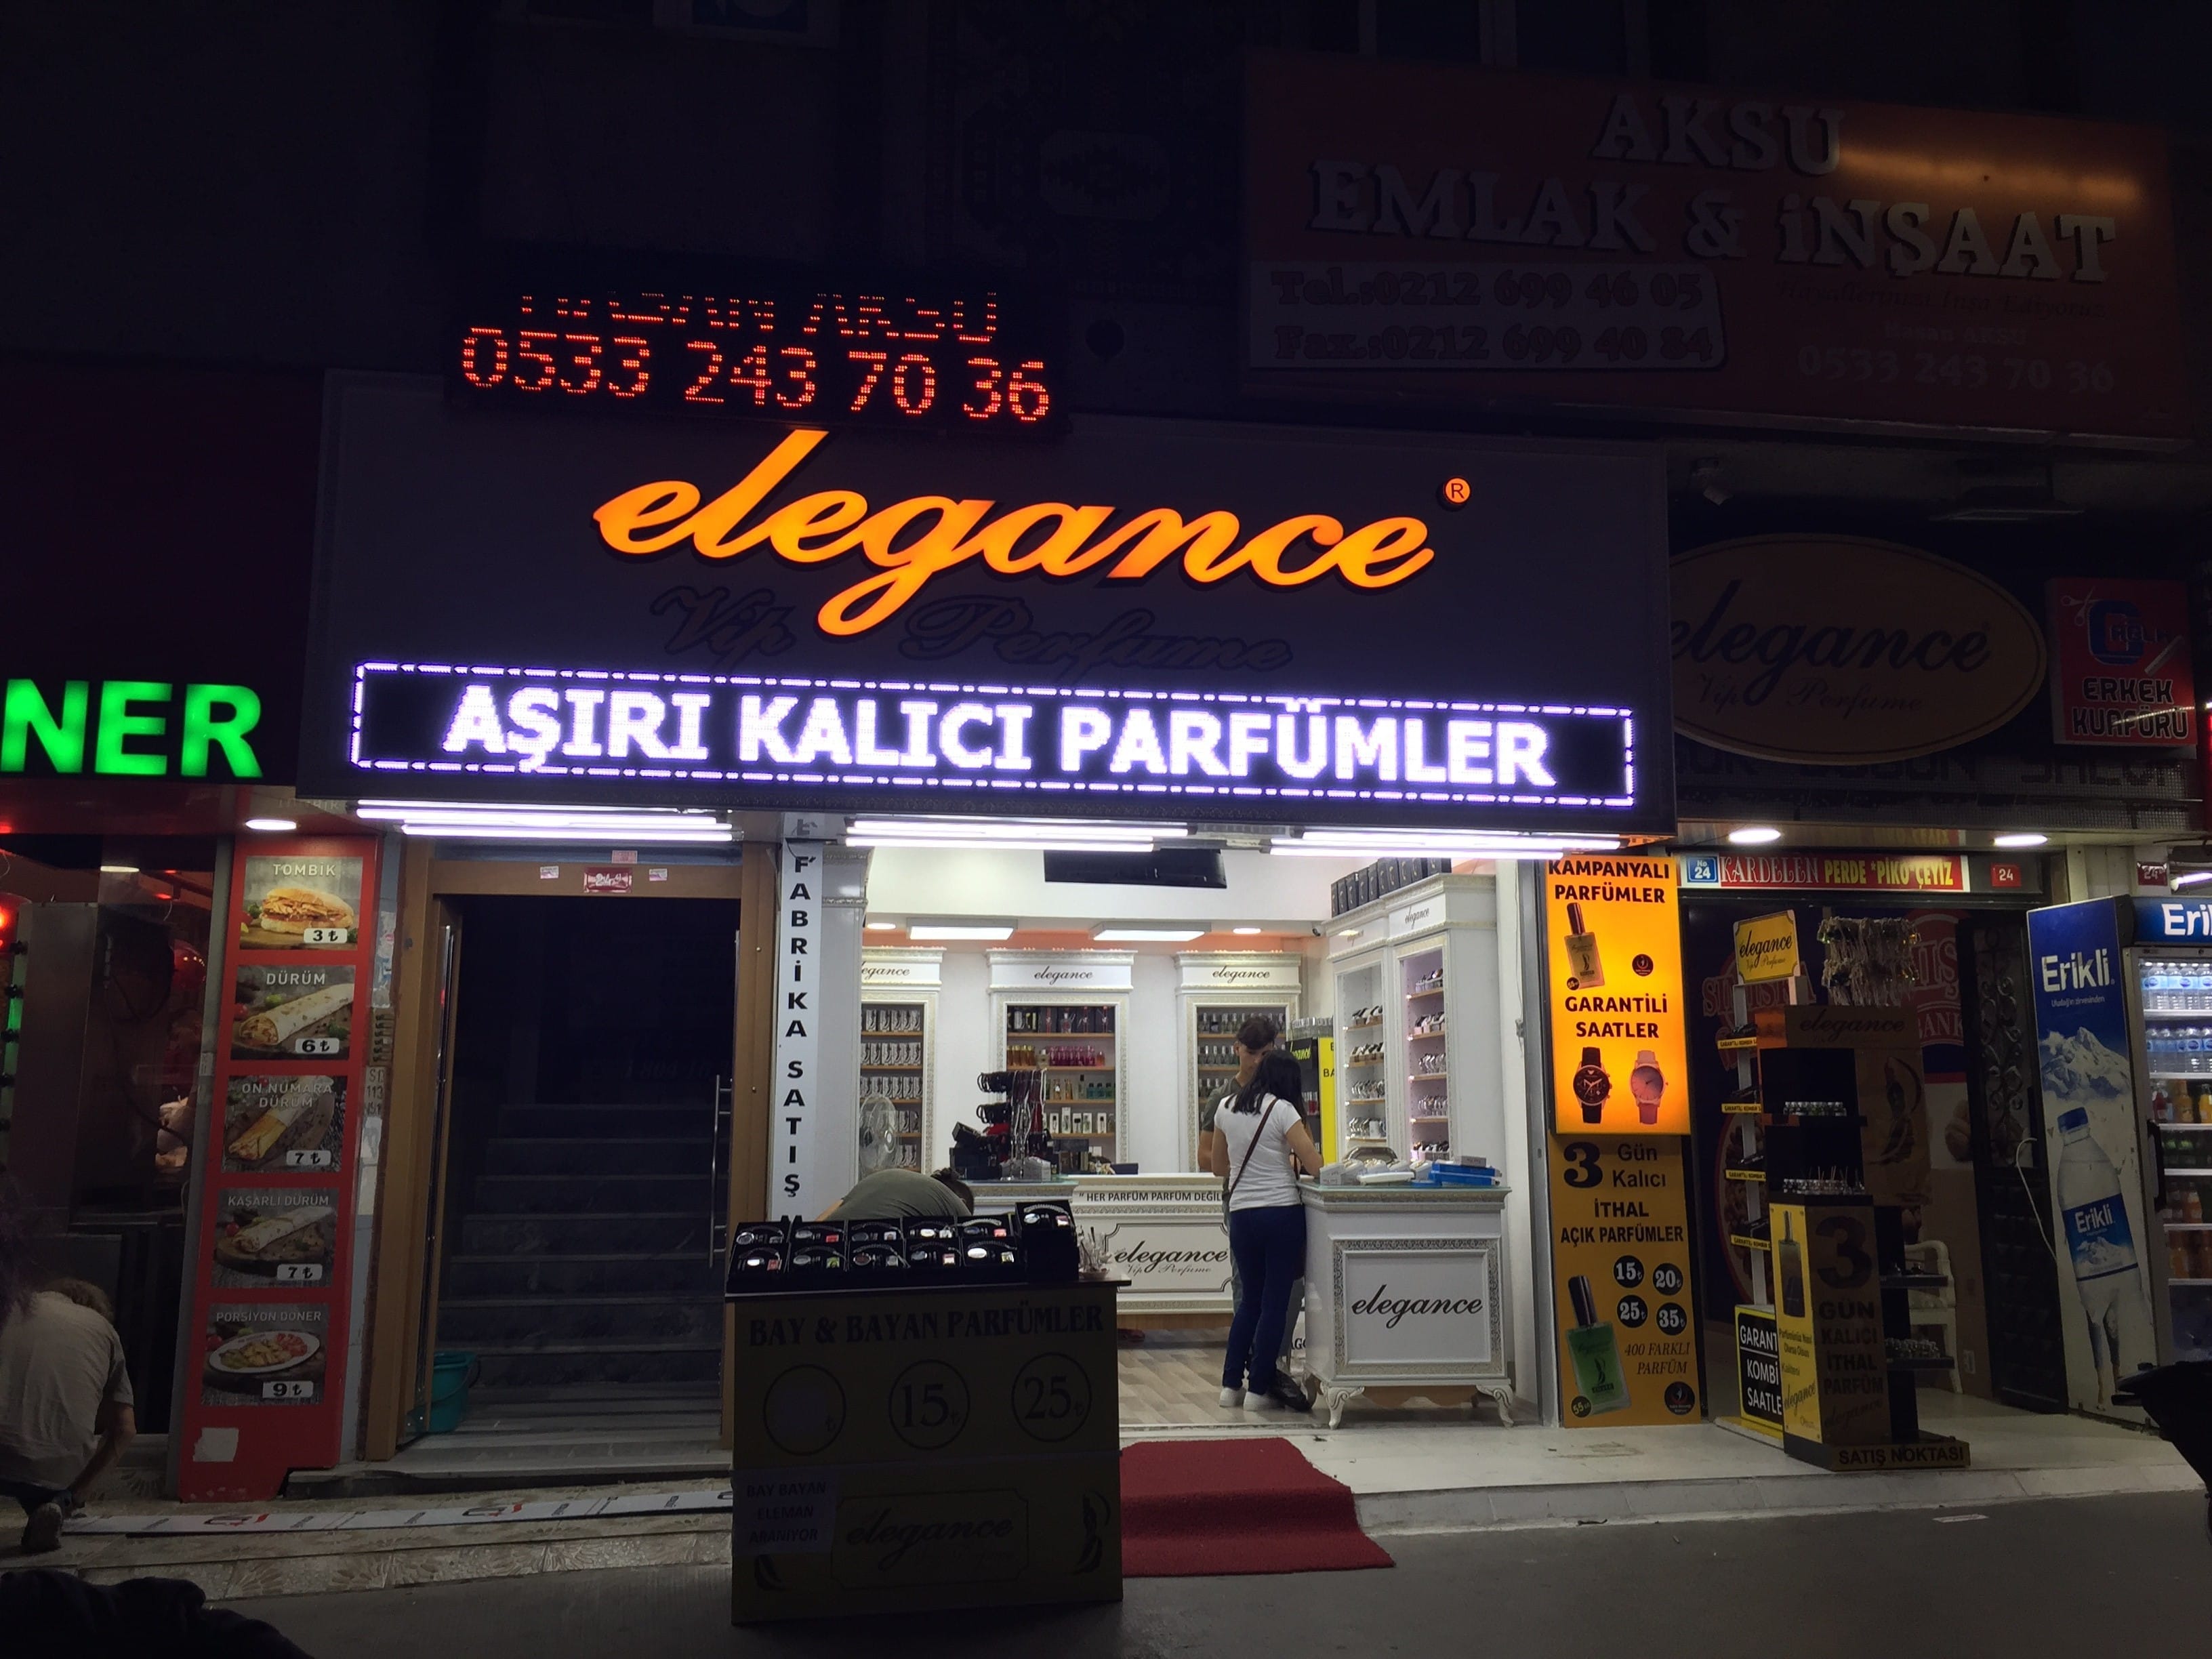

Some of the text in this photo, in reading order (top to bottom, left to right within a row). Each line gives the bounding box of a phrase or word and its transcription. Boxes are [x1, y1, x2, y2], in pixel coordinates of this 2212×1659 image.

[1589, 94, 1845, 175] AKSU
[1306, 160, 1658, 253] EMLAK
[1683, 189, 1747, 260] &
[1494, 270, 1572, 309] 699
[1585, 271, 1638, 308] 46
[1651, 272, 1702, 309] 05
[1502, 325, 1581, 363] 699
[1594, 327, 1647, 362] 40
[1660, 327, 1713, 362] 84
[462, 326, 1050, 422] 0533 243 70 36
[1798, 345, 2115, 395] 0533 243 70 36
[594, 428, 1435, 636] elegance
[1669, 580, 1991, 707] elegance
[2083, 678, 2175, 703] ERKEK
[441, 684, 1557, 788] AŞIRI KALICI PARFÜMLER
[272, 863, 335, 877] TOMBİK
[1549, 859, 1669, 880] KAMPANYALI
[1694, 866, 1711, 879] 24
[1720, 856, 1819, 883] KARDELEN
[1824, 860, 1866, 884] PERDE
[1998, 868, 2014, 882] 24
[1555, 882, 1665, 903] PARFÜMLER
[2160, 903, 2212, 937] Eri
[1739, 930, 1794, 968] elegance
[266, 972, 326, 985] DÜRÜM
[1034, 966, 1094, 985] elegance
[1211, 964, 1271, 984] elegance
[2041, 948, 2110, 993] Erikli
[1565, 992, 1668, 1013] GARANTİLİ
[1575, 1021, 1660, 1038] SAATLER
[1799, 1008, 1905, 1042] elegance
[1563, 1141, 1603, 1188] 3
[1618, 1143, 1658, 1162] Gün
[1612, 1170, 1666, 1188] Kalıcı
[1086, 1193, 1105, 1202] HER
[1108, 1191, 1149, 1202] PARFÜM
[1151, 1191, 1191, 1202] PARFÜM
[1595, 1197, 1650, 1218] İTHAL
[2074, 1203, 2113, 1233] Erikli
[1561, 1223, 1684, 1248] AÇIK PARFÜMLER
[1113, 1240, 1228, 1273] elegance
[1815, 1215, 1872, 1289] 3
[1351, 1284, 1483, 1329] elegance
[1818, 1300, 1875, 1320] GÜN
[750, 1301, 1103, 1347] BAY & BAYAN PARFÜMLER
[1648, 1341, 1691, 1356] FARKLI
[1821, 1328, 1878, 1346] KALICI
[1637, 1358, 1687, 1375] PARFÜM
[1746, 1358, 1779, 1385] KOMBİ
[1826, 1350, 1877, 1371] İTHAL
[1823, 1376, 1883, 1395] PARFÜM
[1747, 1387, 1782, 1416] SAATLE
[1838, 1446, 1964, 1467] SATIŞ NOKTASI
[746, 1481, 827, 1498] BAY BAYAN
[757, 1505, 813, 1520] ELEMAN
[845, 1507, 1015, 1572] elegance
